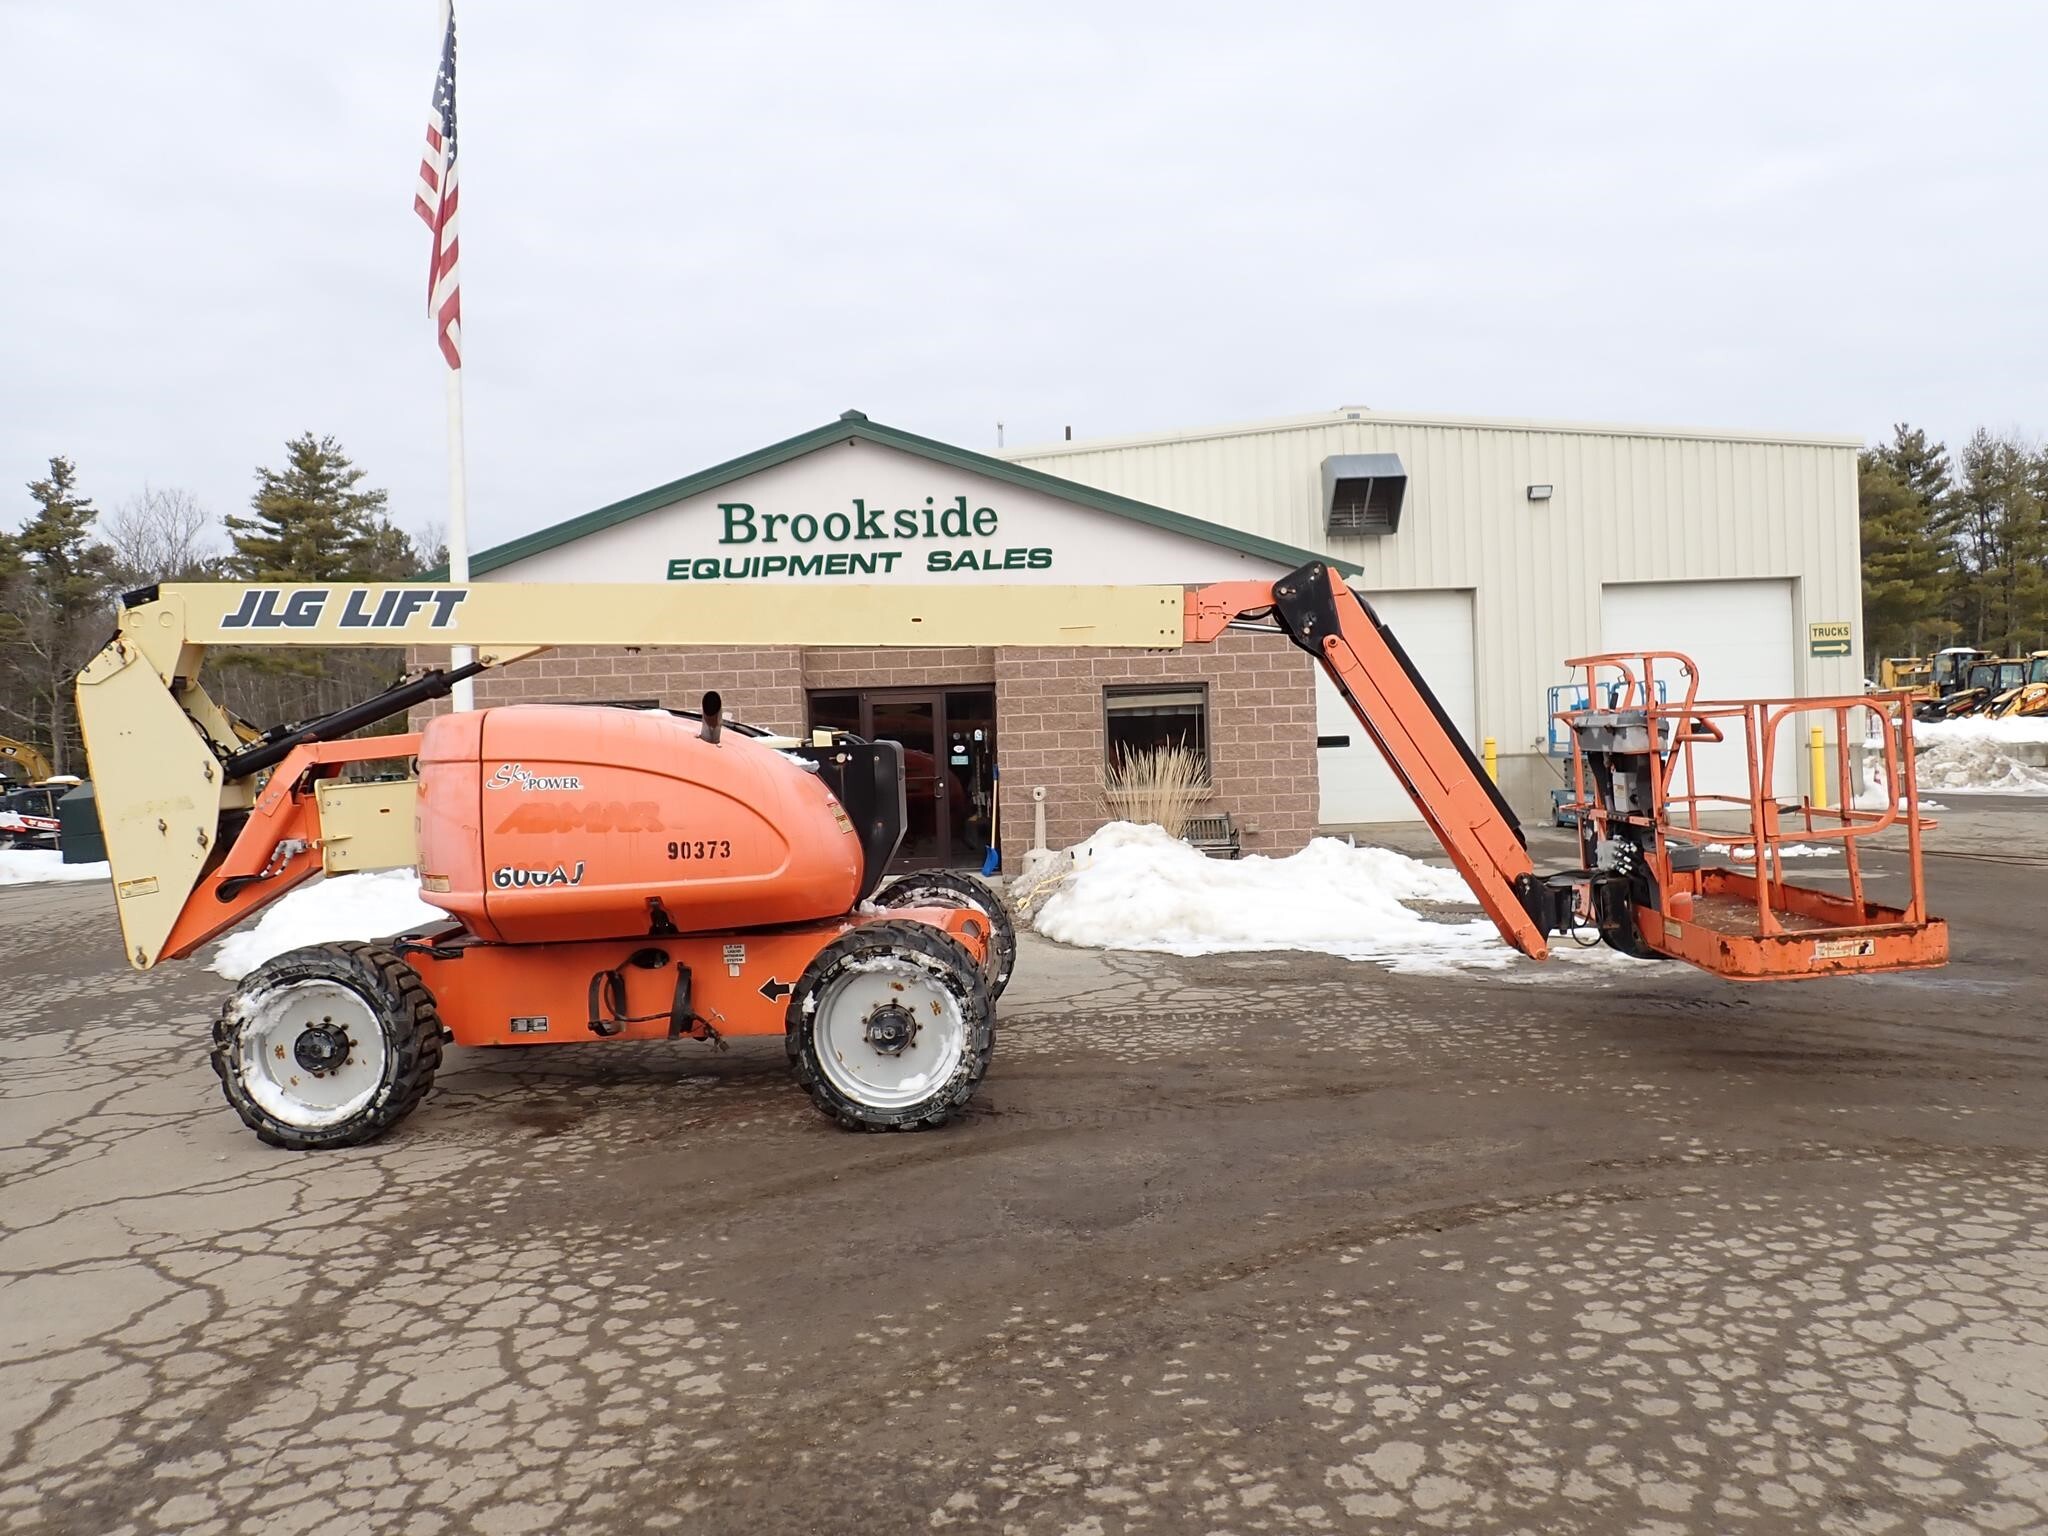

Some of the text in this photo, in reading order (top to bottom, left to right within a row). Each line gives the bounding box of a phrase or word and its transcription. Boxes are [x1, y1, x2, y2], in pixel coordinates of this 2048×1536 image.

[717, 496, 999, 545] Brookside
[666, 547, 1053, 581] EQUIPMENT SALES
[220, 588, 468, 628] JLG LIFT
[1812, 626, 1849, 637] TRUCKS
[528, 777, 580, 790] POWER
[667, 840, 730, 860] 90373
